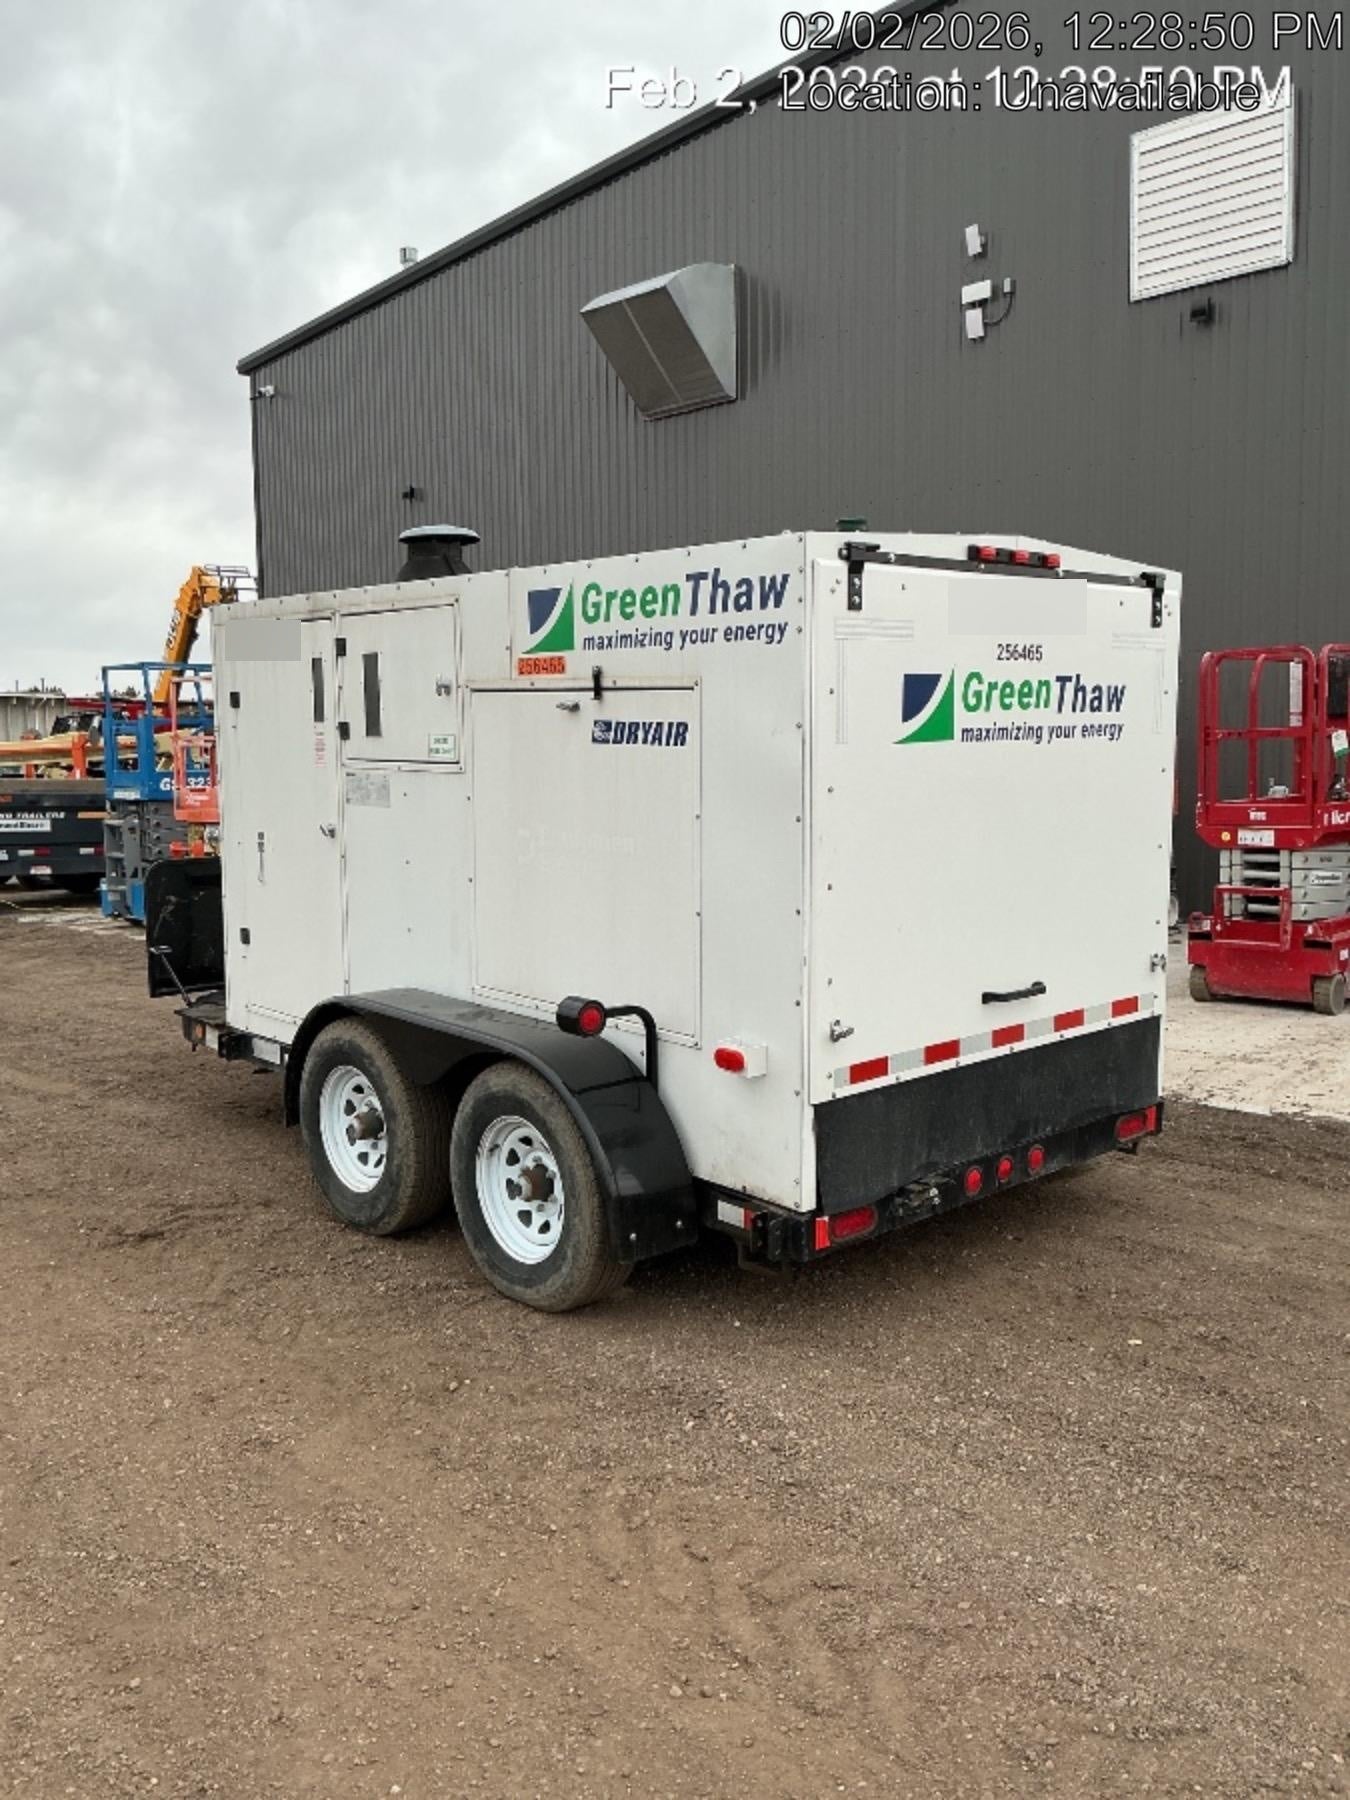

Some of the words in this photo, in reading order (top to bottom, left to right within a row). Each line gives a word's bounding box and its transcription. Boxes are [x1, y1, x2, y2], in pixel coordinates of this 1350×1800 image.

[583, 628, 673, 651] maximizing
[679, 626, 718, 650] your
[724, 622, 789, 645] energy
[997, 643, 1043, 661] 256465
[518, 657, 566, 675] 256465
[611, 721, 689, 746] DRYAIR
[961, 722, 1043, 744] maximizing
[1047, 724, 1079, 744] your
[1081, 723, 1125, 741] energy
